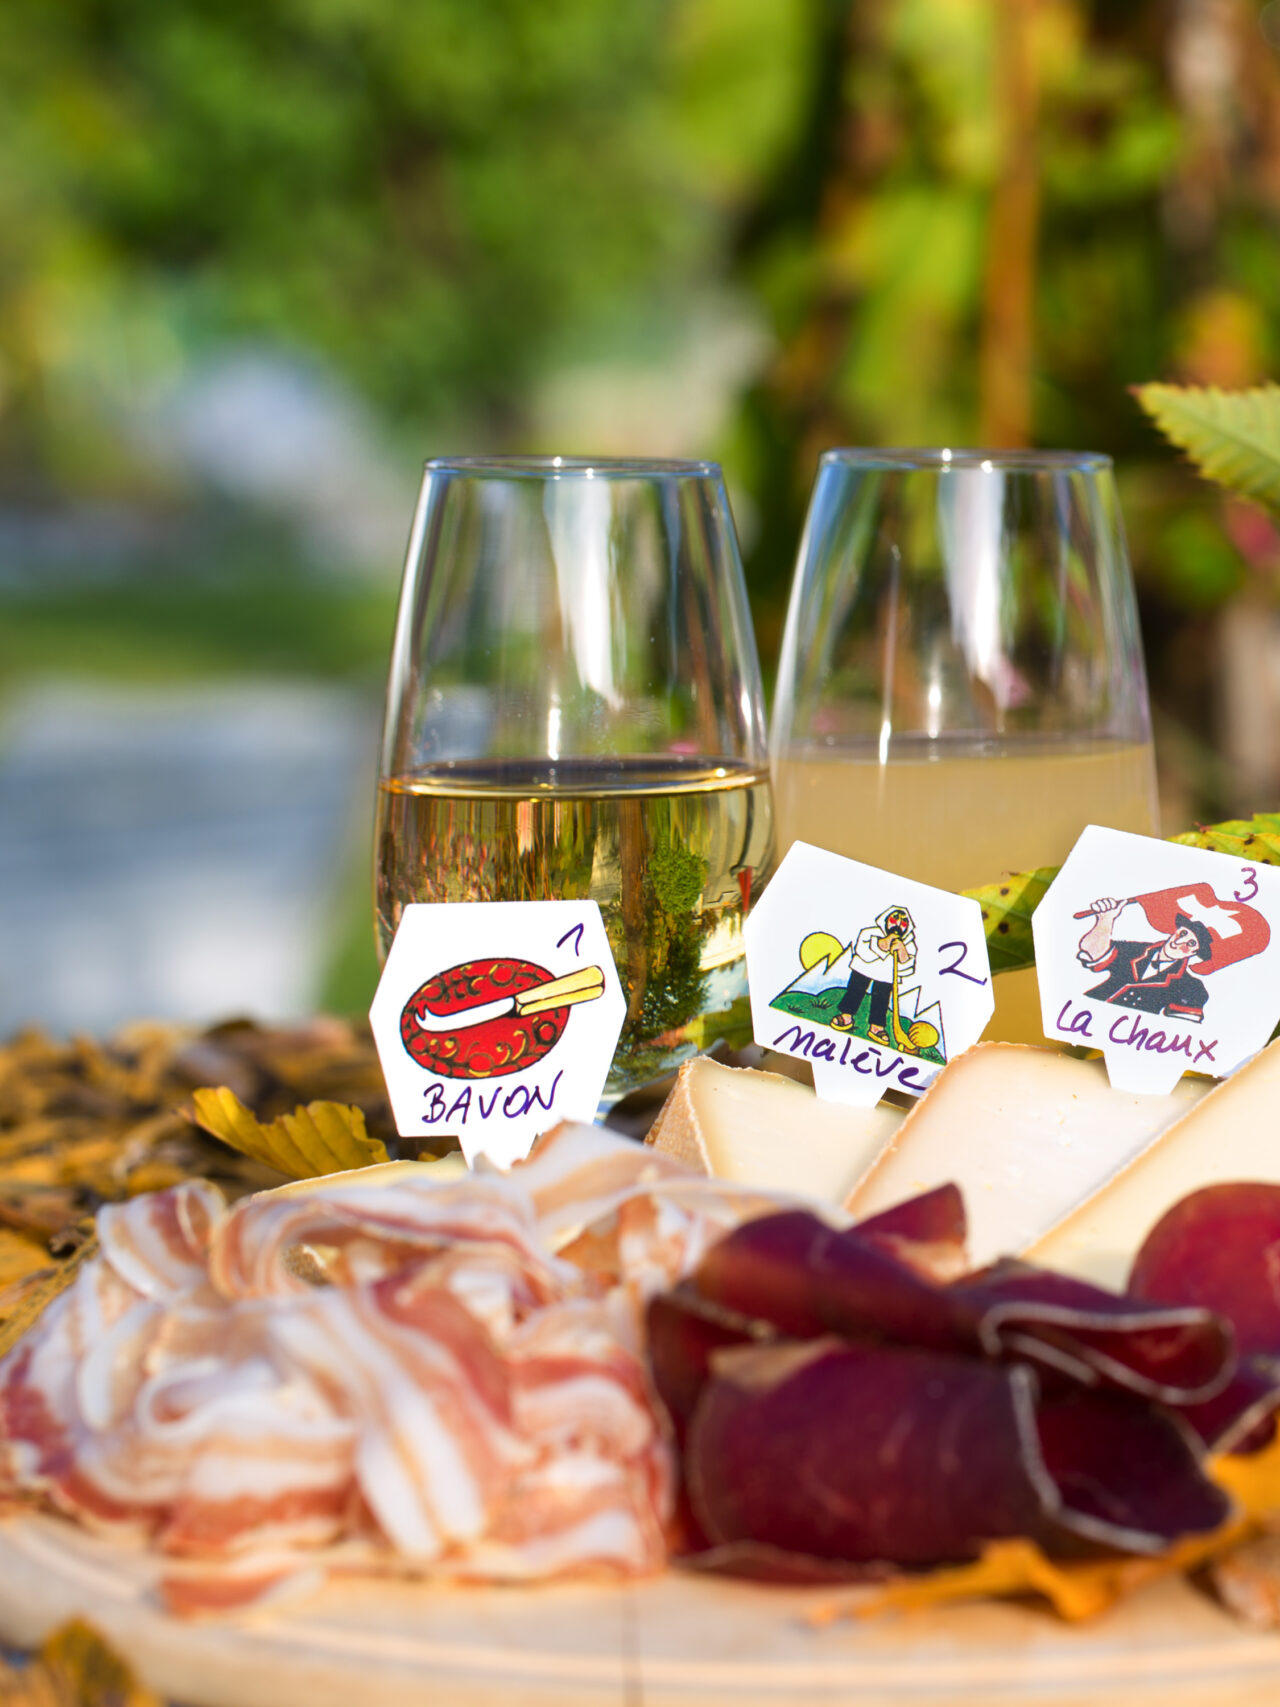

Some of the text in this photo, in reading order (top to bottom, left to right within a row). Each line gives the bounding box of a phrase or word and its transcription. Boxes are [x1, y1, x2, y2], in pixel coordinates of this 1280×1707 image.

[1233, 867, 1259, 903] 3
[556, 922, 585, 957] 1
[937, 941, 988, 986] 2
[1056, 1000, 1219, 1063] La Chaux
[421, 1069, 564, 1125] BAVON
